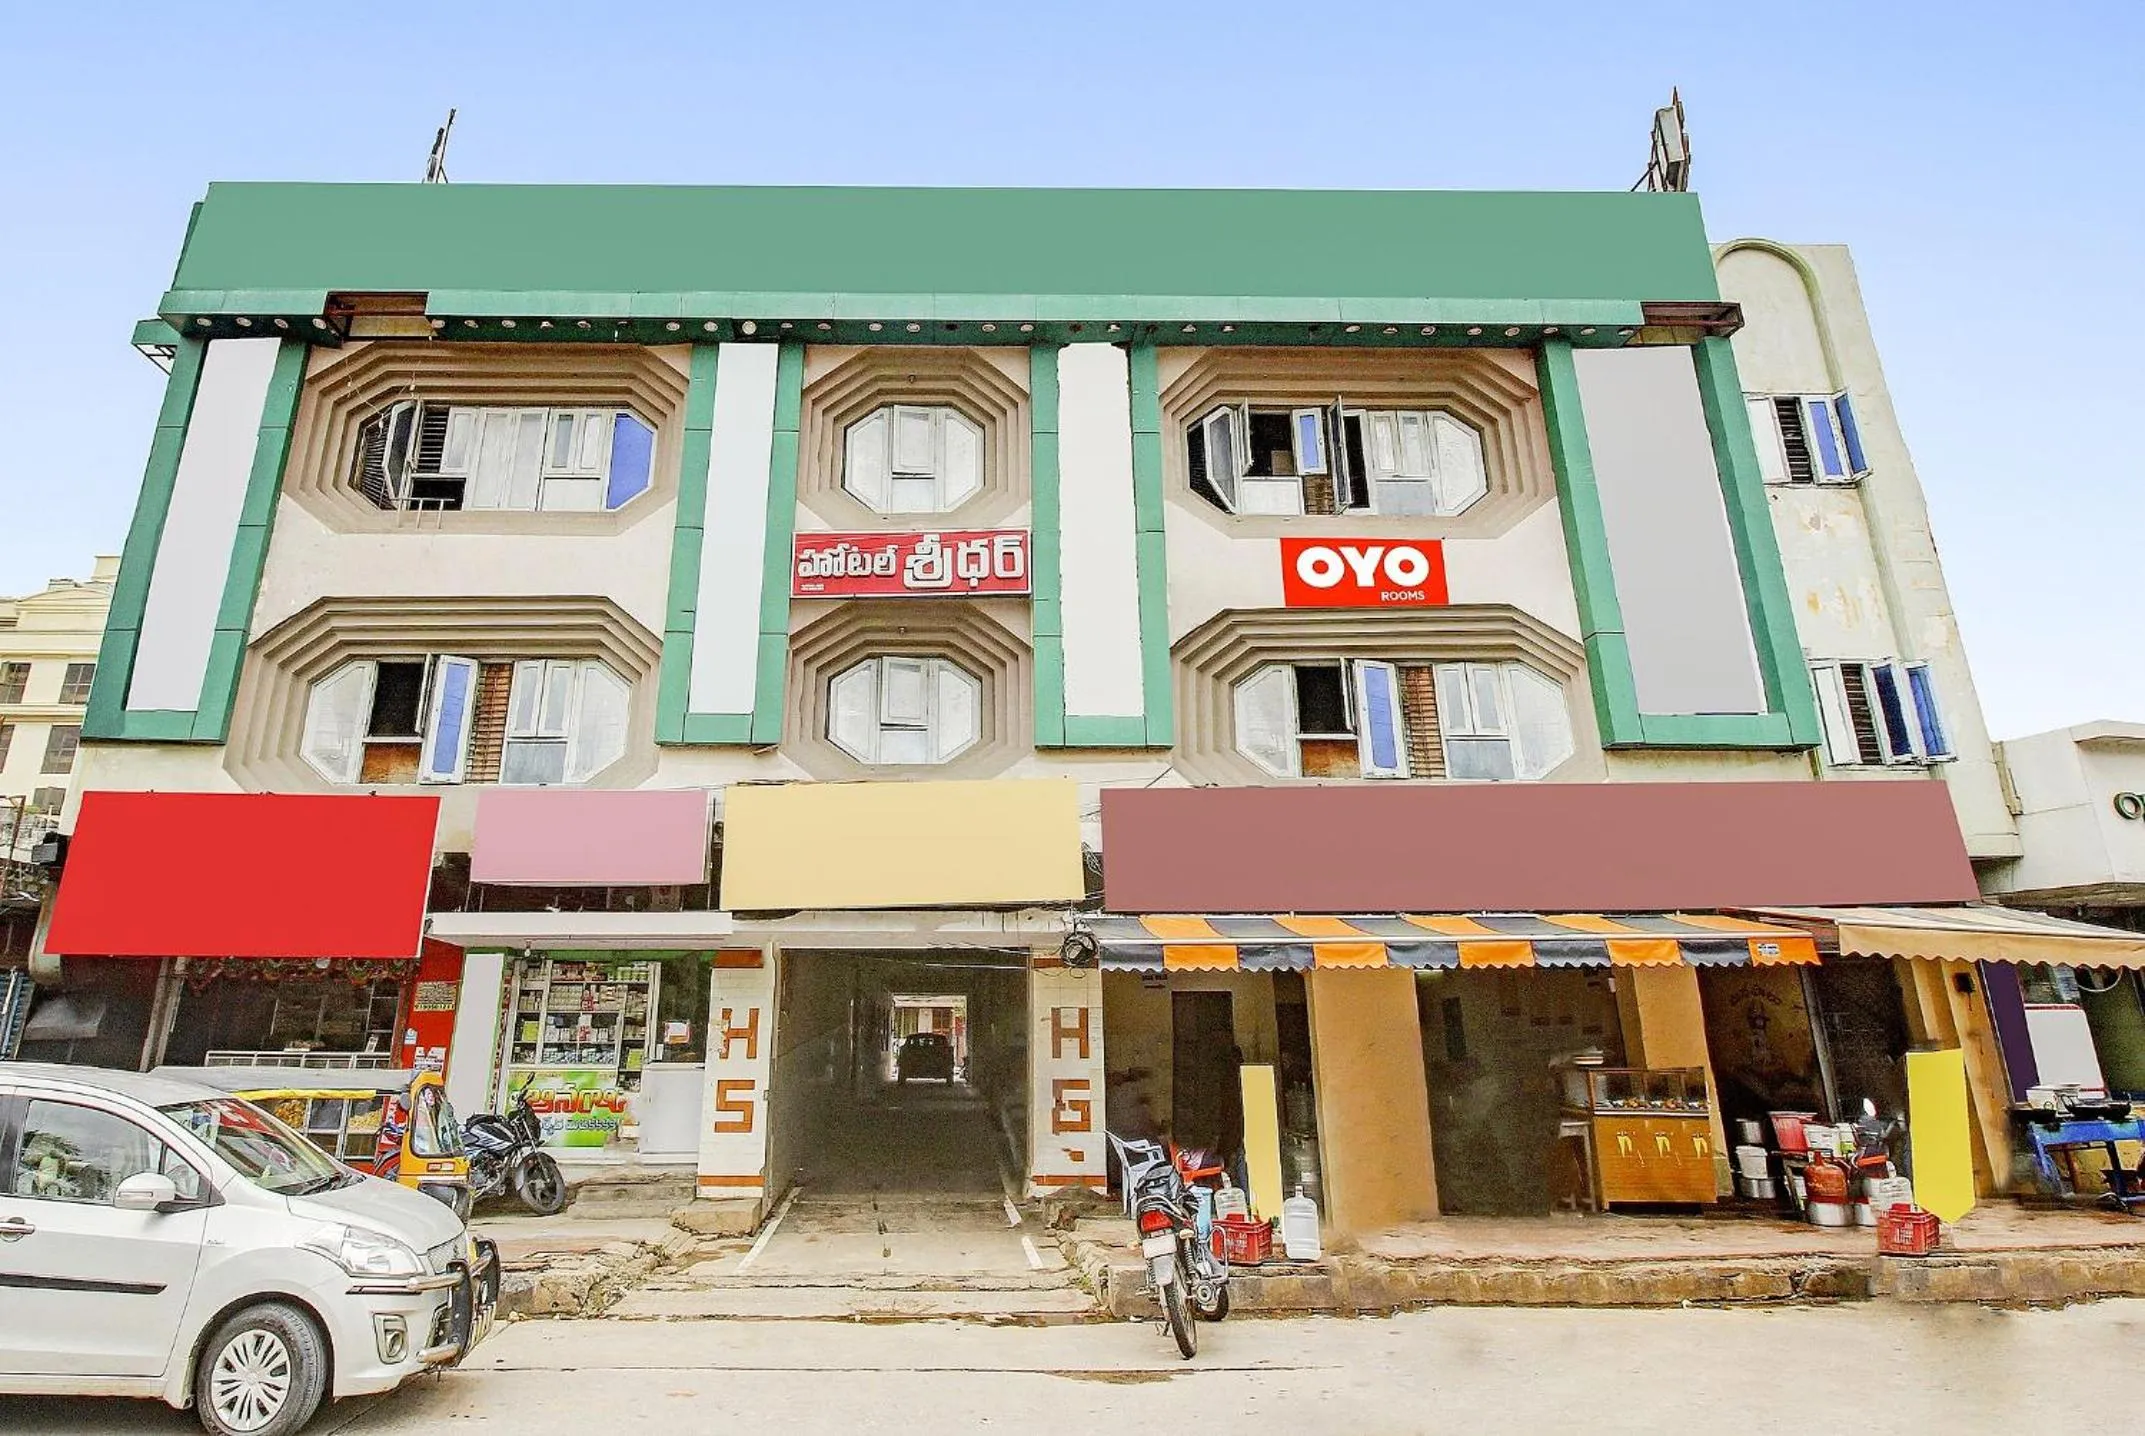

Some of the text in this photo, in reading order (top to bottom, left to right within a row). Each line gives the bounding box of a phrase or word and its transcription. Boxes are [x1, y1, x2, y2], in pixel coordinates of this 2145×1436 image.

[903, 533, 1025, 589] శ్రీధర్
[1296, 545, 1430, 588] OYO
[1380, 591, 1425, 601] ROOMS
